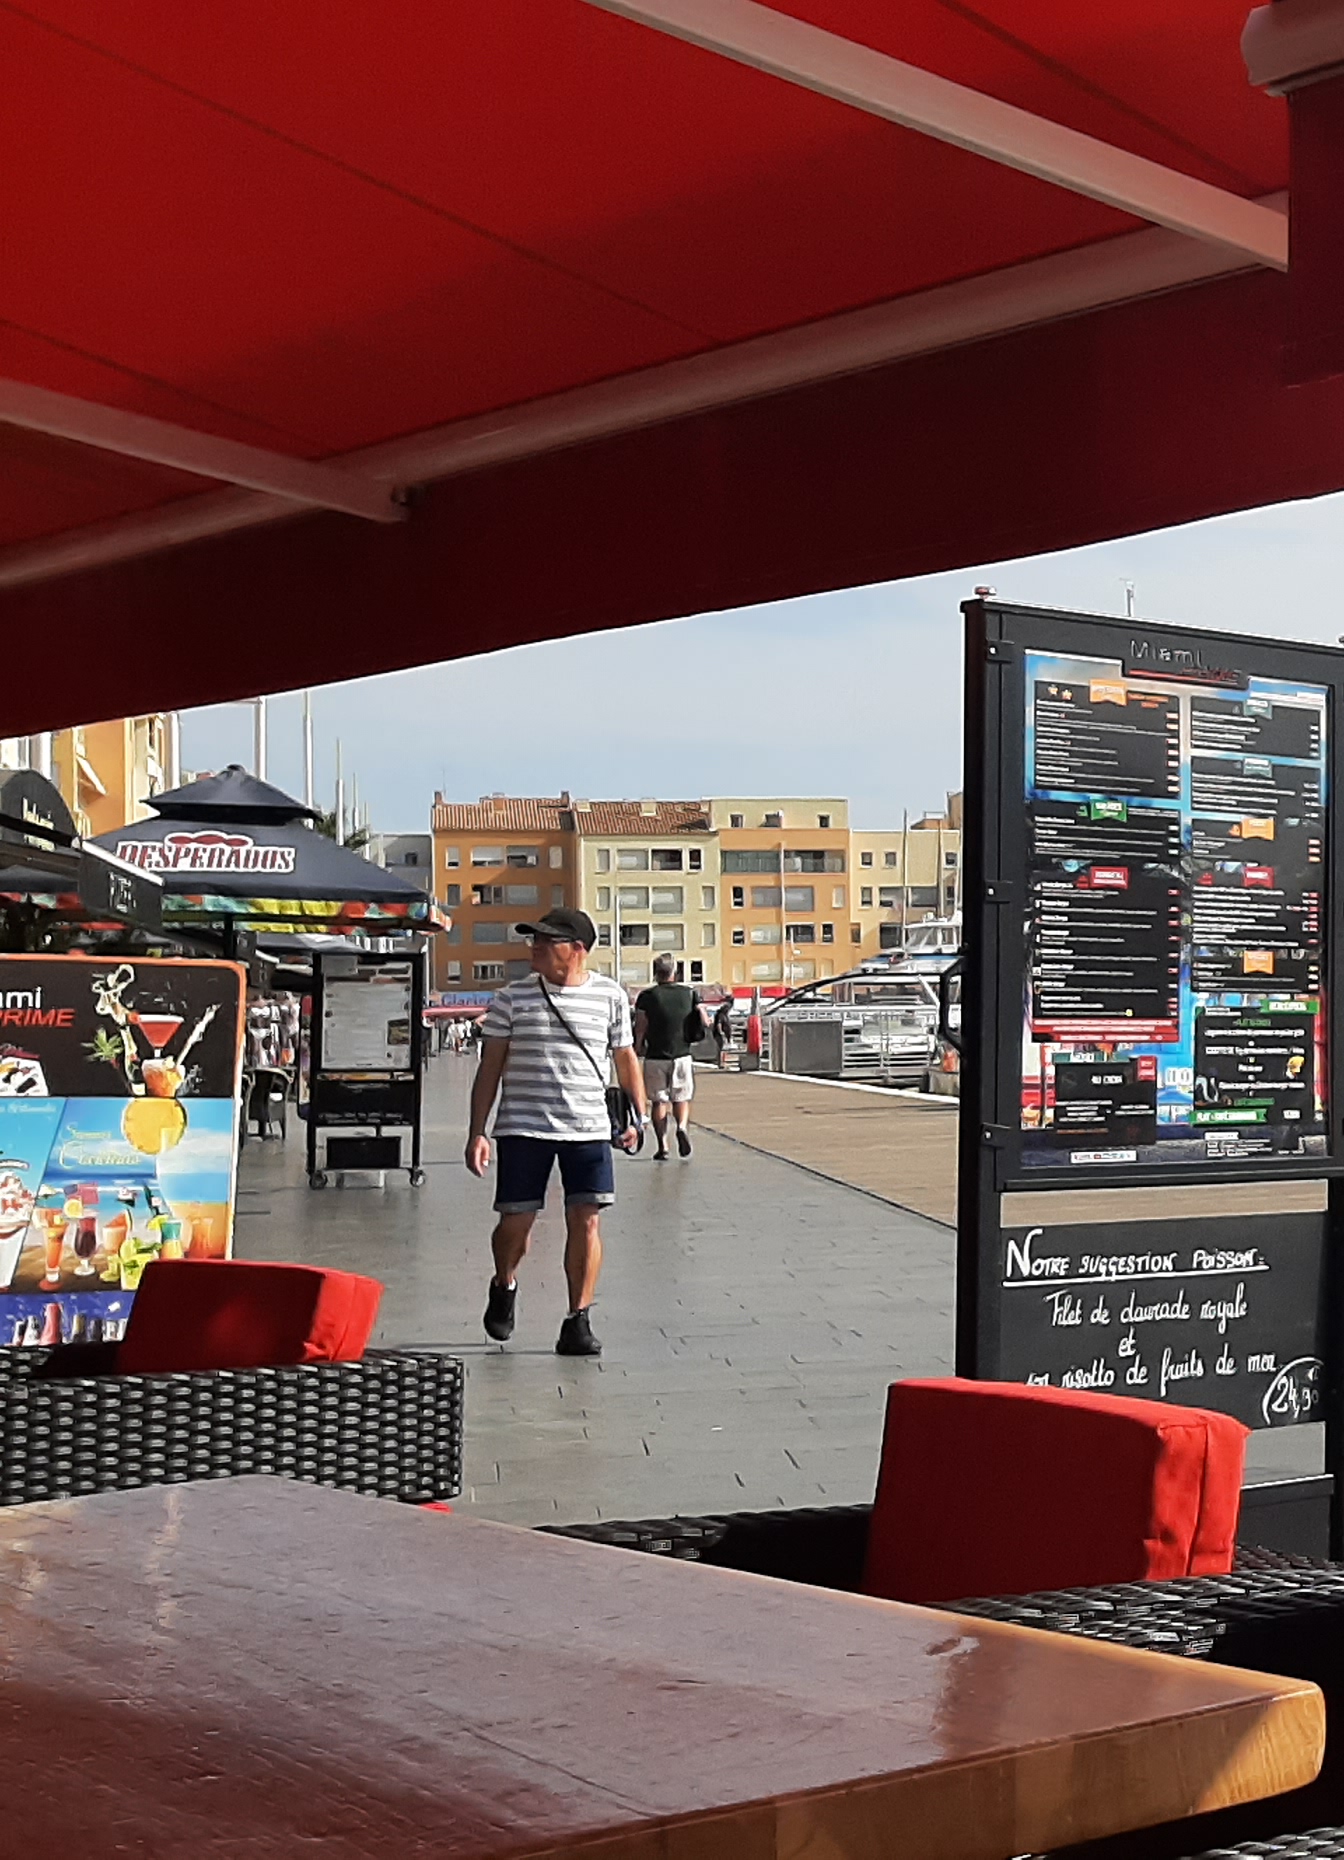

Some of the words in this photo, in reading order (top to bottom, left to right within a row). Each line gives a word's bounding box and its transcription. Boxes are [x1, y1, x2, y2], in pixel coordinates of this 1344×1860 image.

[1130, 640, 1203, 667] Miami
[116, 842, 296, 873] DESPERADOS
[0, 986, 42, 1009] mi
[0, 1008, 76, 1028] RIME
[1006, 1228, 1069, 1279] NOTRE
[1079, 1250, 1177, 1281] SUGGESTION
[1044, 1289, 1083, 1327] Filet
[1090, 1303, 1111, 1326] de
[1120, 1288, 1191, 1325] daurade
[1200, 1282, 1249, 1334] royale
[1118, 1326, 1138, 1357] et
[1061, 1359, 1115, 1389] risotto
[1126, 1353, 1149, 1384] de
[1160, 1346, 1204, 1397] fruits
[1215, 1342, 1238, 1374] de
